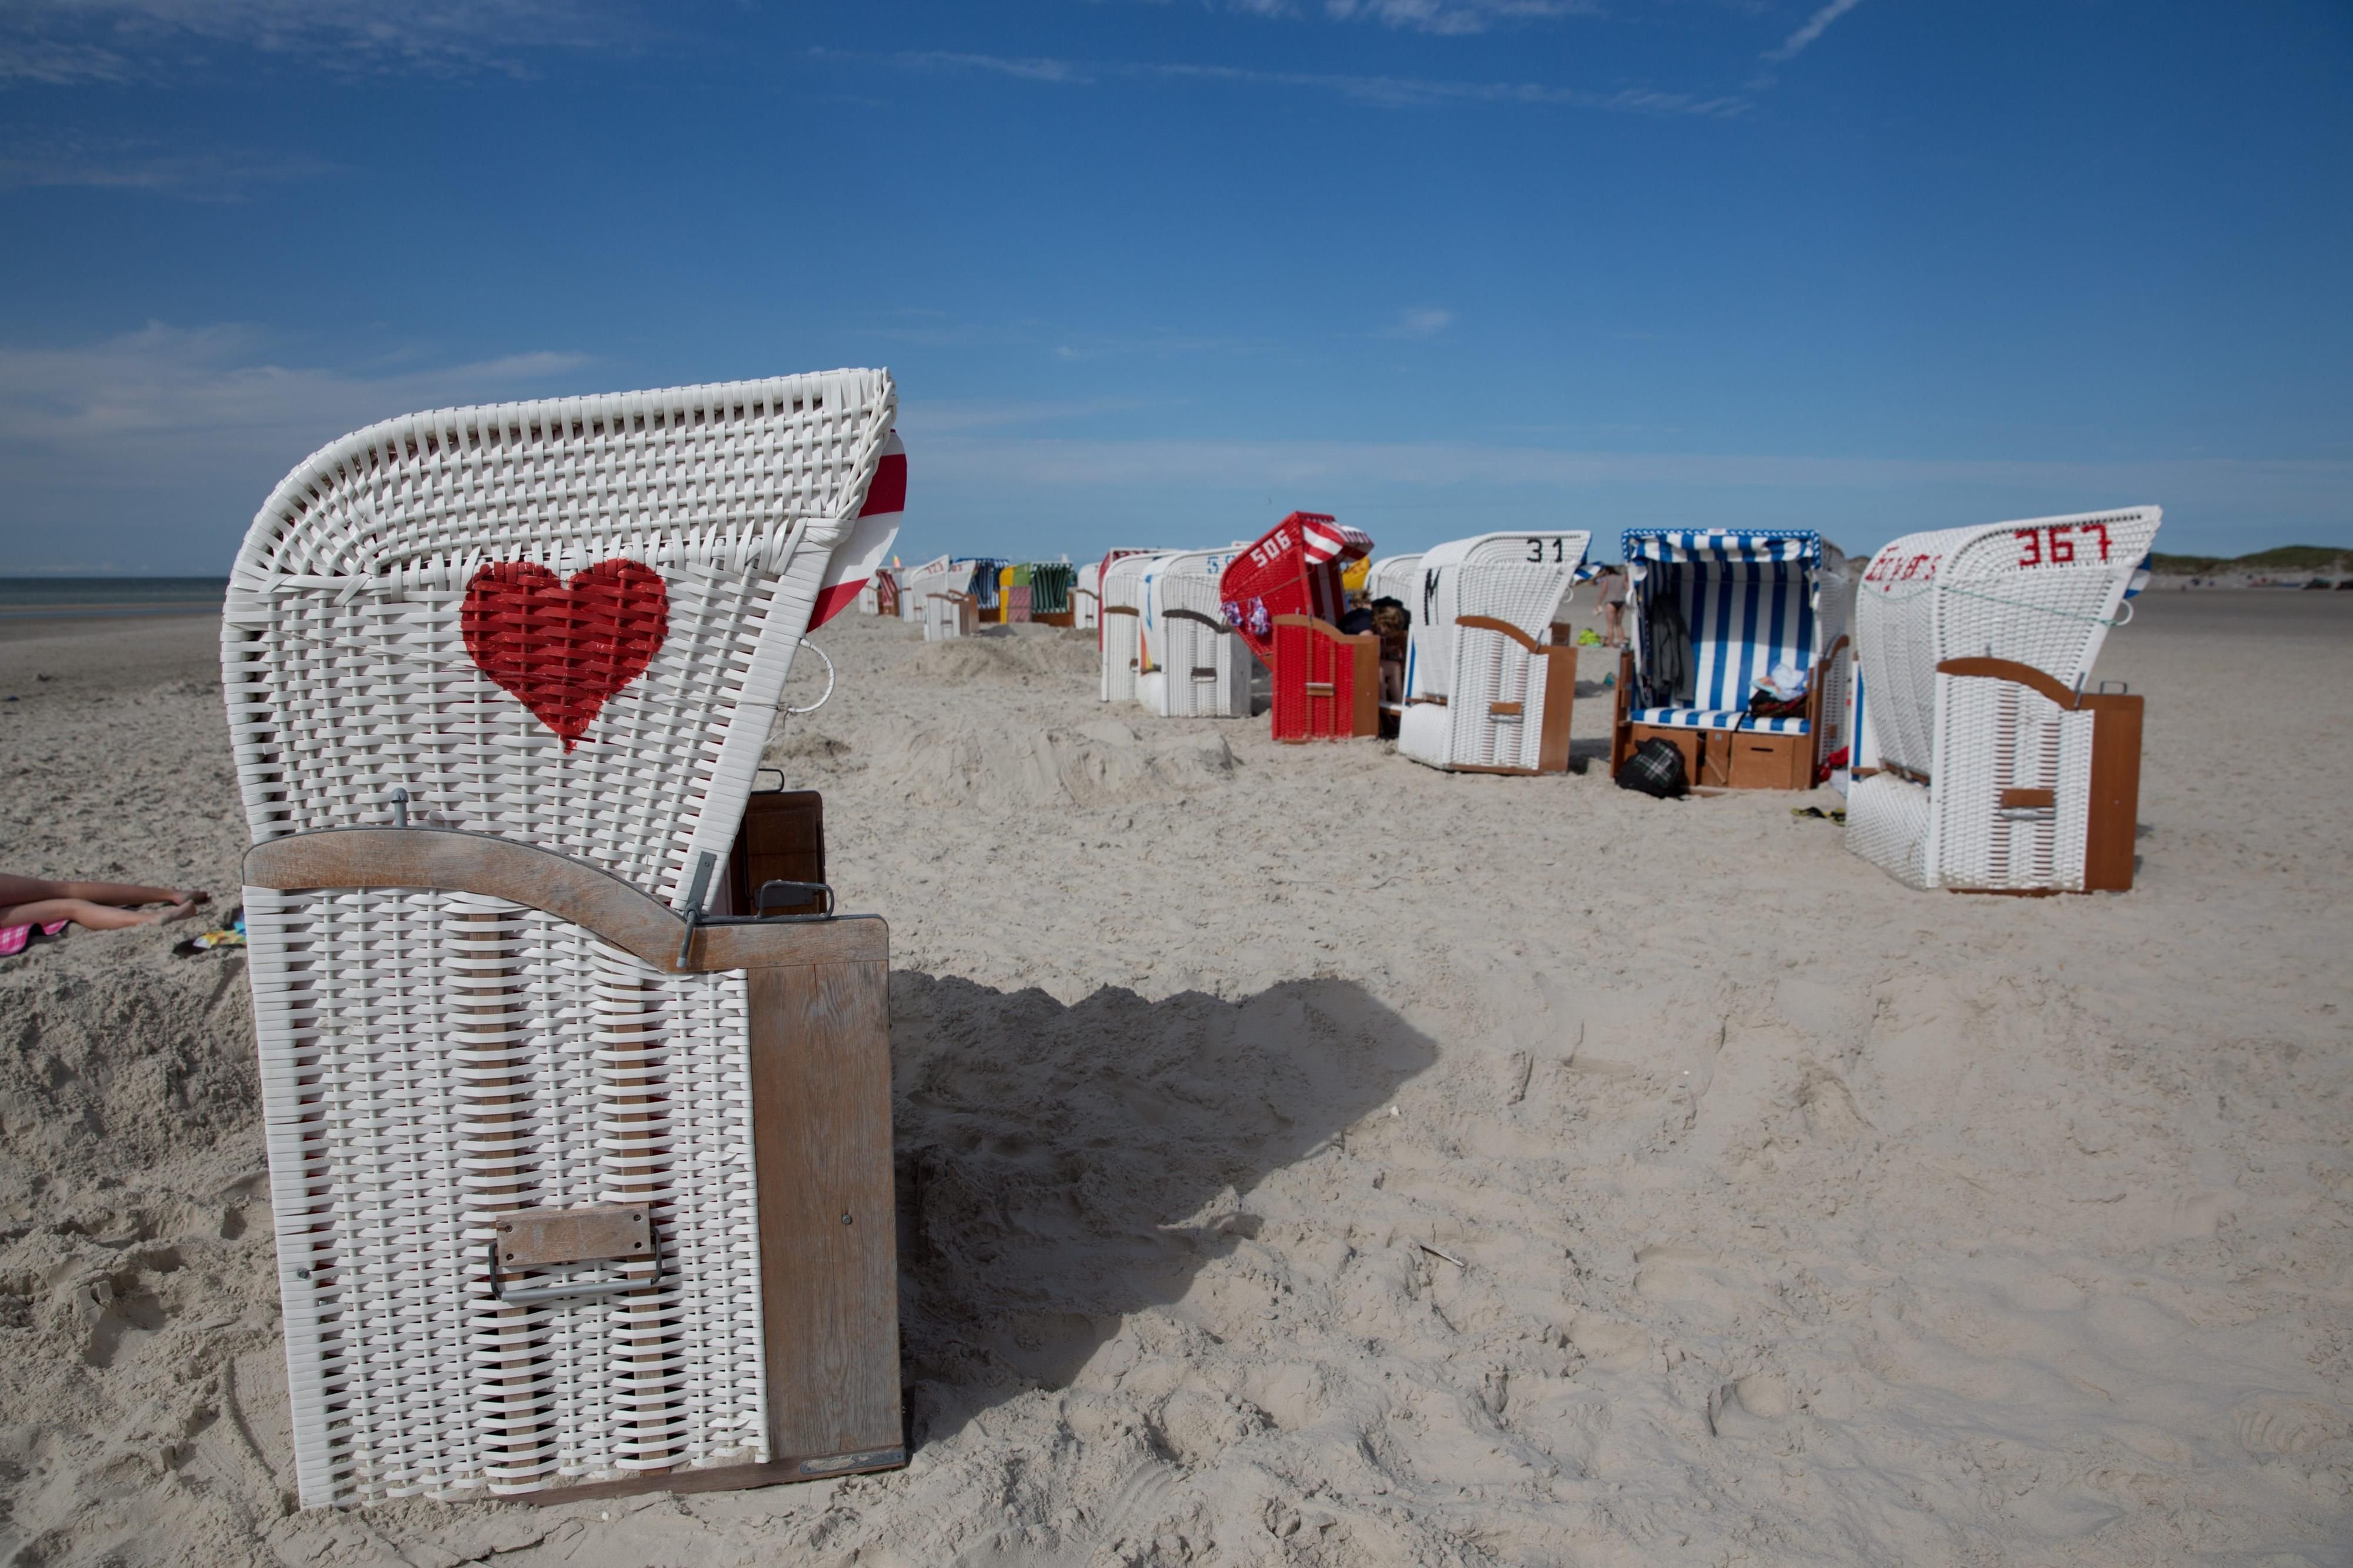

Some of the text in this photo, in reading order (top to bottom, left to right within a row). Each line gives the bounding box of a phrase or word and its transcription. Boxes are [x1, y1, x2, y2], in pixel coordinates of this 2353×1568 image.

[1249, 529, 1292, 568] 506
[1527, 538, 1562, 563] 31
[2014, 523, 2112, 566] 367
